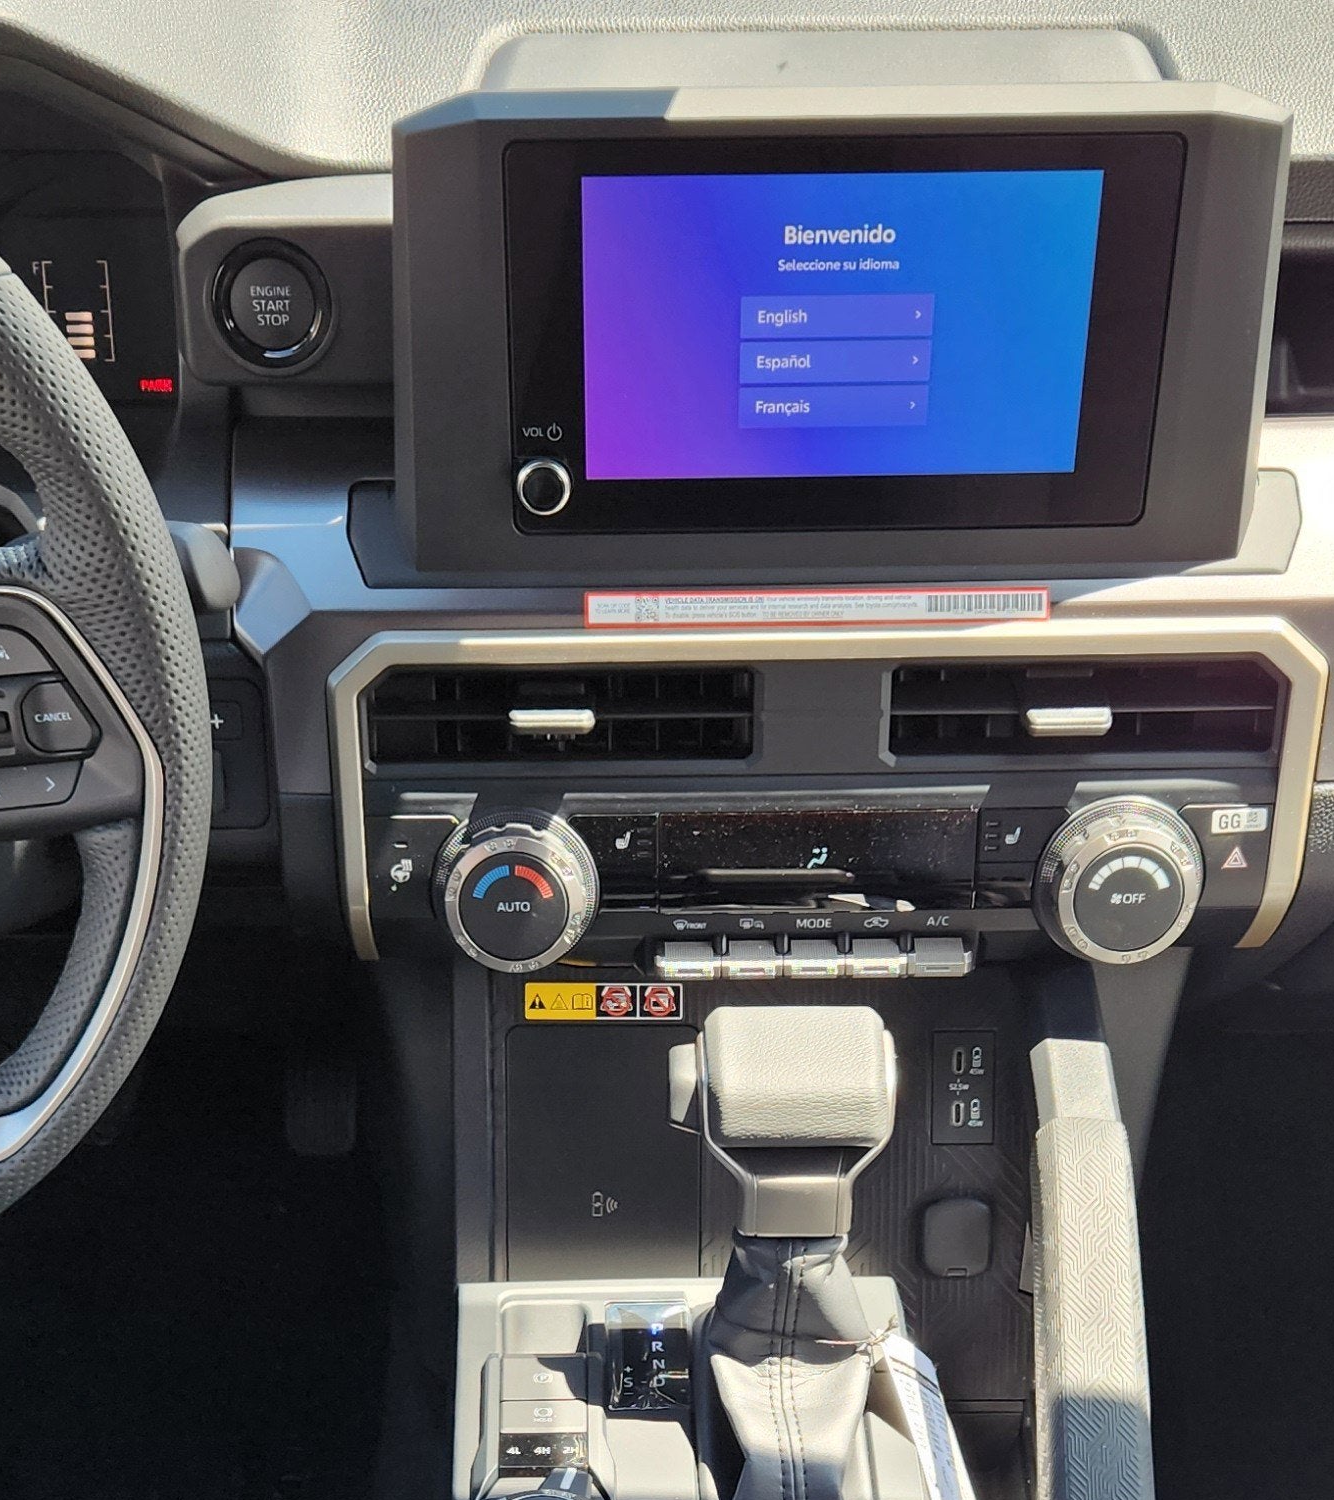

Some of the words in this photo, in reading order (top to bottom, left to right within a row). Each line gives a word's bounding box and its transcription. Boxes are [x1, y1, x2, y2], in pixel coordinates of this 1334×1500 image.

[784, 223, 897, 245] Bienvenido
[32, 261, 40, 275] F
[777, 259, 842, 272] Seleccione
[842, 260, 857, 271] su
[858, 258, 900, 271] idioma
[250, 285, 291, 297] ENGINE
[252, 299, 291, 313] START
[256, 313, 290, 326] STOP
[757, 309, 808, 327] English
[756, 355, 811, 372] Español
[755, 400, 811, 417] Français
[522, 427, 544, 437] VOL
[34, 711, 72, 723] CANCEL
[1218, 814, 1241, 830] GG
[1122, 893, 1146, 905] OFF
[496, 901, 531, 913] AUTO
[686, 922, 707, 930] FRONT
[796, 917, 832, 929] MODE
[926, 915, 950, 927] A/C
[651, 1323, 664, 1335] P
[651, 1341, 665, 1352] R
[652, 1359, 666, 1370] N
[623, 1377, 634, 1388] S
[653, 1375, 666, 1387] D
[506, 1446, 521, 1455] 4L
[534, 1446, 551, 1455] 4H
